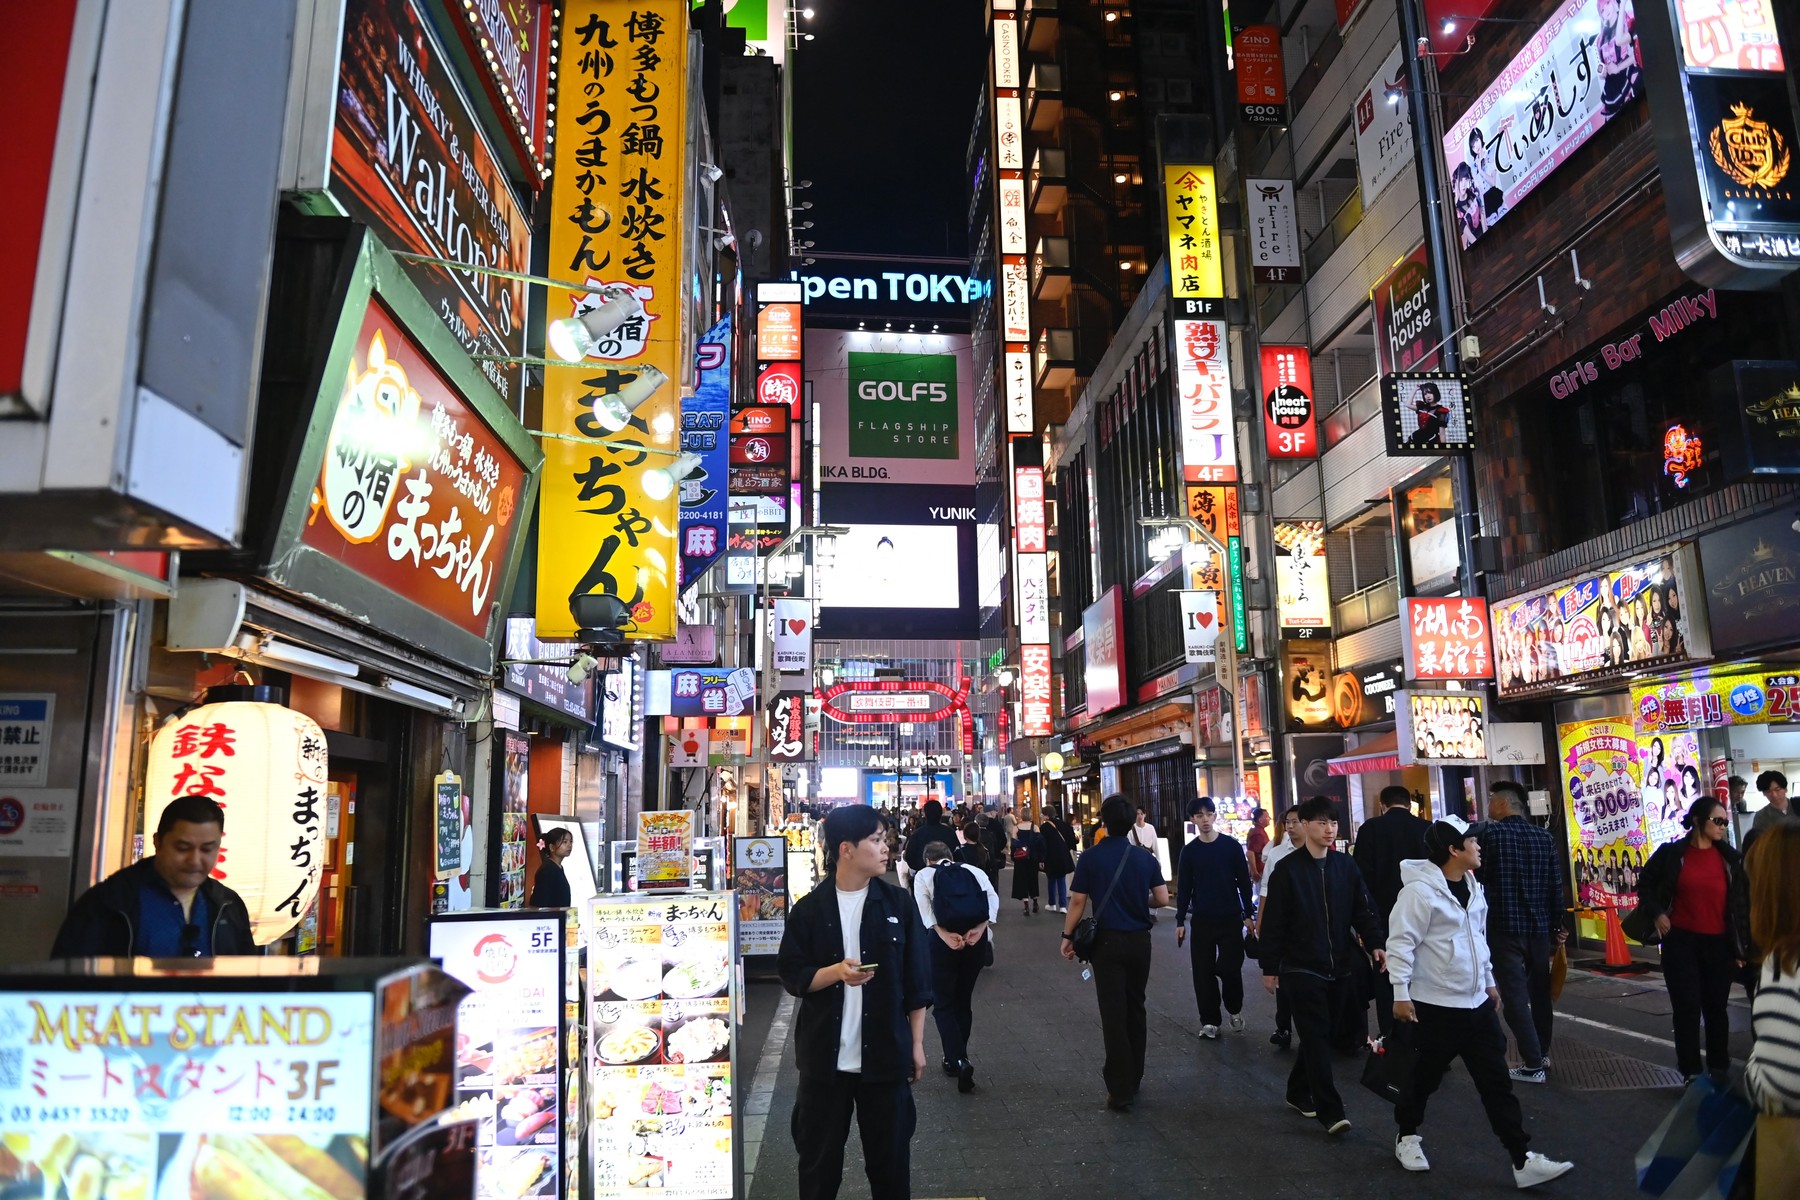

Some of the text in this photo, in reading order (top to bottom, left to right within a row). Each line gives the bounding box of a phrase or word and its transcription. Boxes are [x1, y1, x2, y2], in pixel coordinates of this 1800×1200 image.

[1009, 12, 1015, 20] 9
[1242, 36, 1270, 44] ZINO
[1001, 23, 1012, 84] CASINO POKER
[1245, 105, 1275, 115] 600
[398, 33, 510, 251] WHISKY & BEER BAR
[569, 14, 618, 272] 九州のうまかもん
[620, 11, 666, 279] 博多もつ鍋 水炊き
[1378, 121, 1403, 159] Fire
[1512, 106, 1590, 184] Dear My Sister
[384, 72, 511, 337] Walton's
[1199, 194, 1212, 260] やきとん酒場
[1268, 205, 1281, 254] Fire
[1175, 194, 1200, 293] ヤマネ肉店
[1259, 227, 1268, 261] Ice
[1018, 256, 1025, 264] 6
[1267, 267, 1288, 281] 4F
[1186, 300, 1212, 314] B1F
[1390, 277, 1431, 334] meat
[1389, 308, 1432, 373] house
[1550, 288, 1718, 400] Girls Bar Milky
[858, 381, 948, 402] GOLF5
[1275, 387, 1310, 406] meat
[1272, 401, 1307, 424] house
[859, 421, 949, 432] FLAGSHIP
[893, 434, 949, 444] STORE
[1278, 431, 1306, 452] 3F
[852, 467, 891, 479] BLDG.
[1197, 466, 1224, 481] 4F
[570, 369, 652, 604] まっちゃん
[1227, 492, 1239, 531] 炭火串焼
[1018, 500, 1044, 550] 焼肉
[388, 468, 495, 616] まっちゃん
[687, 527, 716, 555] 麻
[1738, 566, 1797, 597] HEAVEN
[1565, 582, 1593, 617] 話して
[634, 606, 650, 618] 松
[1188, 612, 1197, 630] I
[1414, 599, 1484, 639] 湖南
[780, 618, 788, 636] I
[1299, 629, 1313, 638] 2F
[1418, 641, 1470, 675] 菜館
[676, 673, 699, 695] 麻
[702, 675, 727, 685] フリー
[1023, 647, 1051, 729] 安楽亭
[1769, 677, 1796, 686] 入会金
[703, 689, 725, 710] 雀
[1658, 686, 1686, 699] すべて
[1731, 688, 1760, 707] 男性
[1640, 699, 1658, 716] 女性
[1663, 693, 1721, 724] 無料!
[1589, 725, 1609, 736] ただいま
[275, 785, 320, 919] まっちゃん
[647, 835, 683, 852] 半額!
[666, 902, 724, 922] まっちゃん
[531, 932, 554, 948] 5F
[28, 1000, 162, 1052] MEAT
[168, 1004, 335, 1051] STAND
[30, 1057, 340, 1101] ミートスタンド 3F
